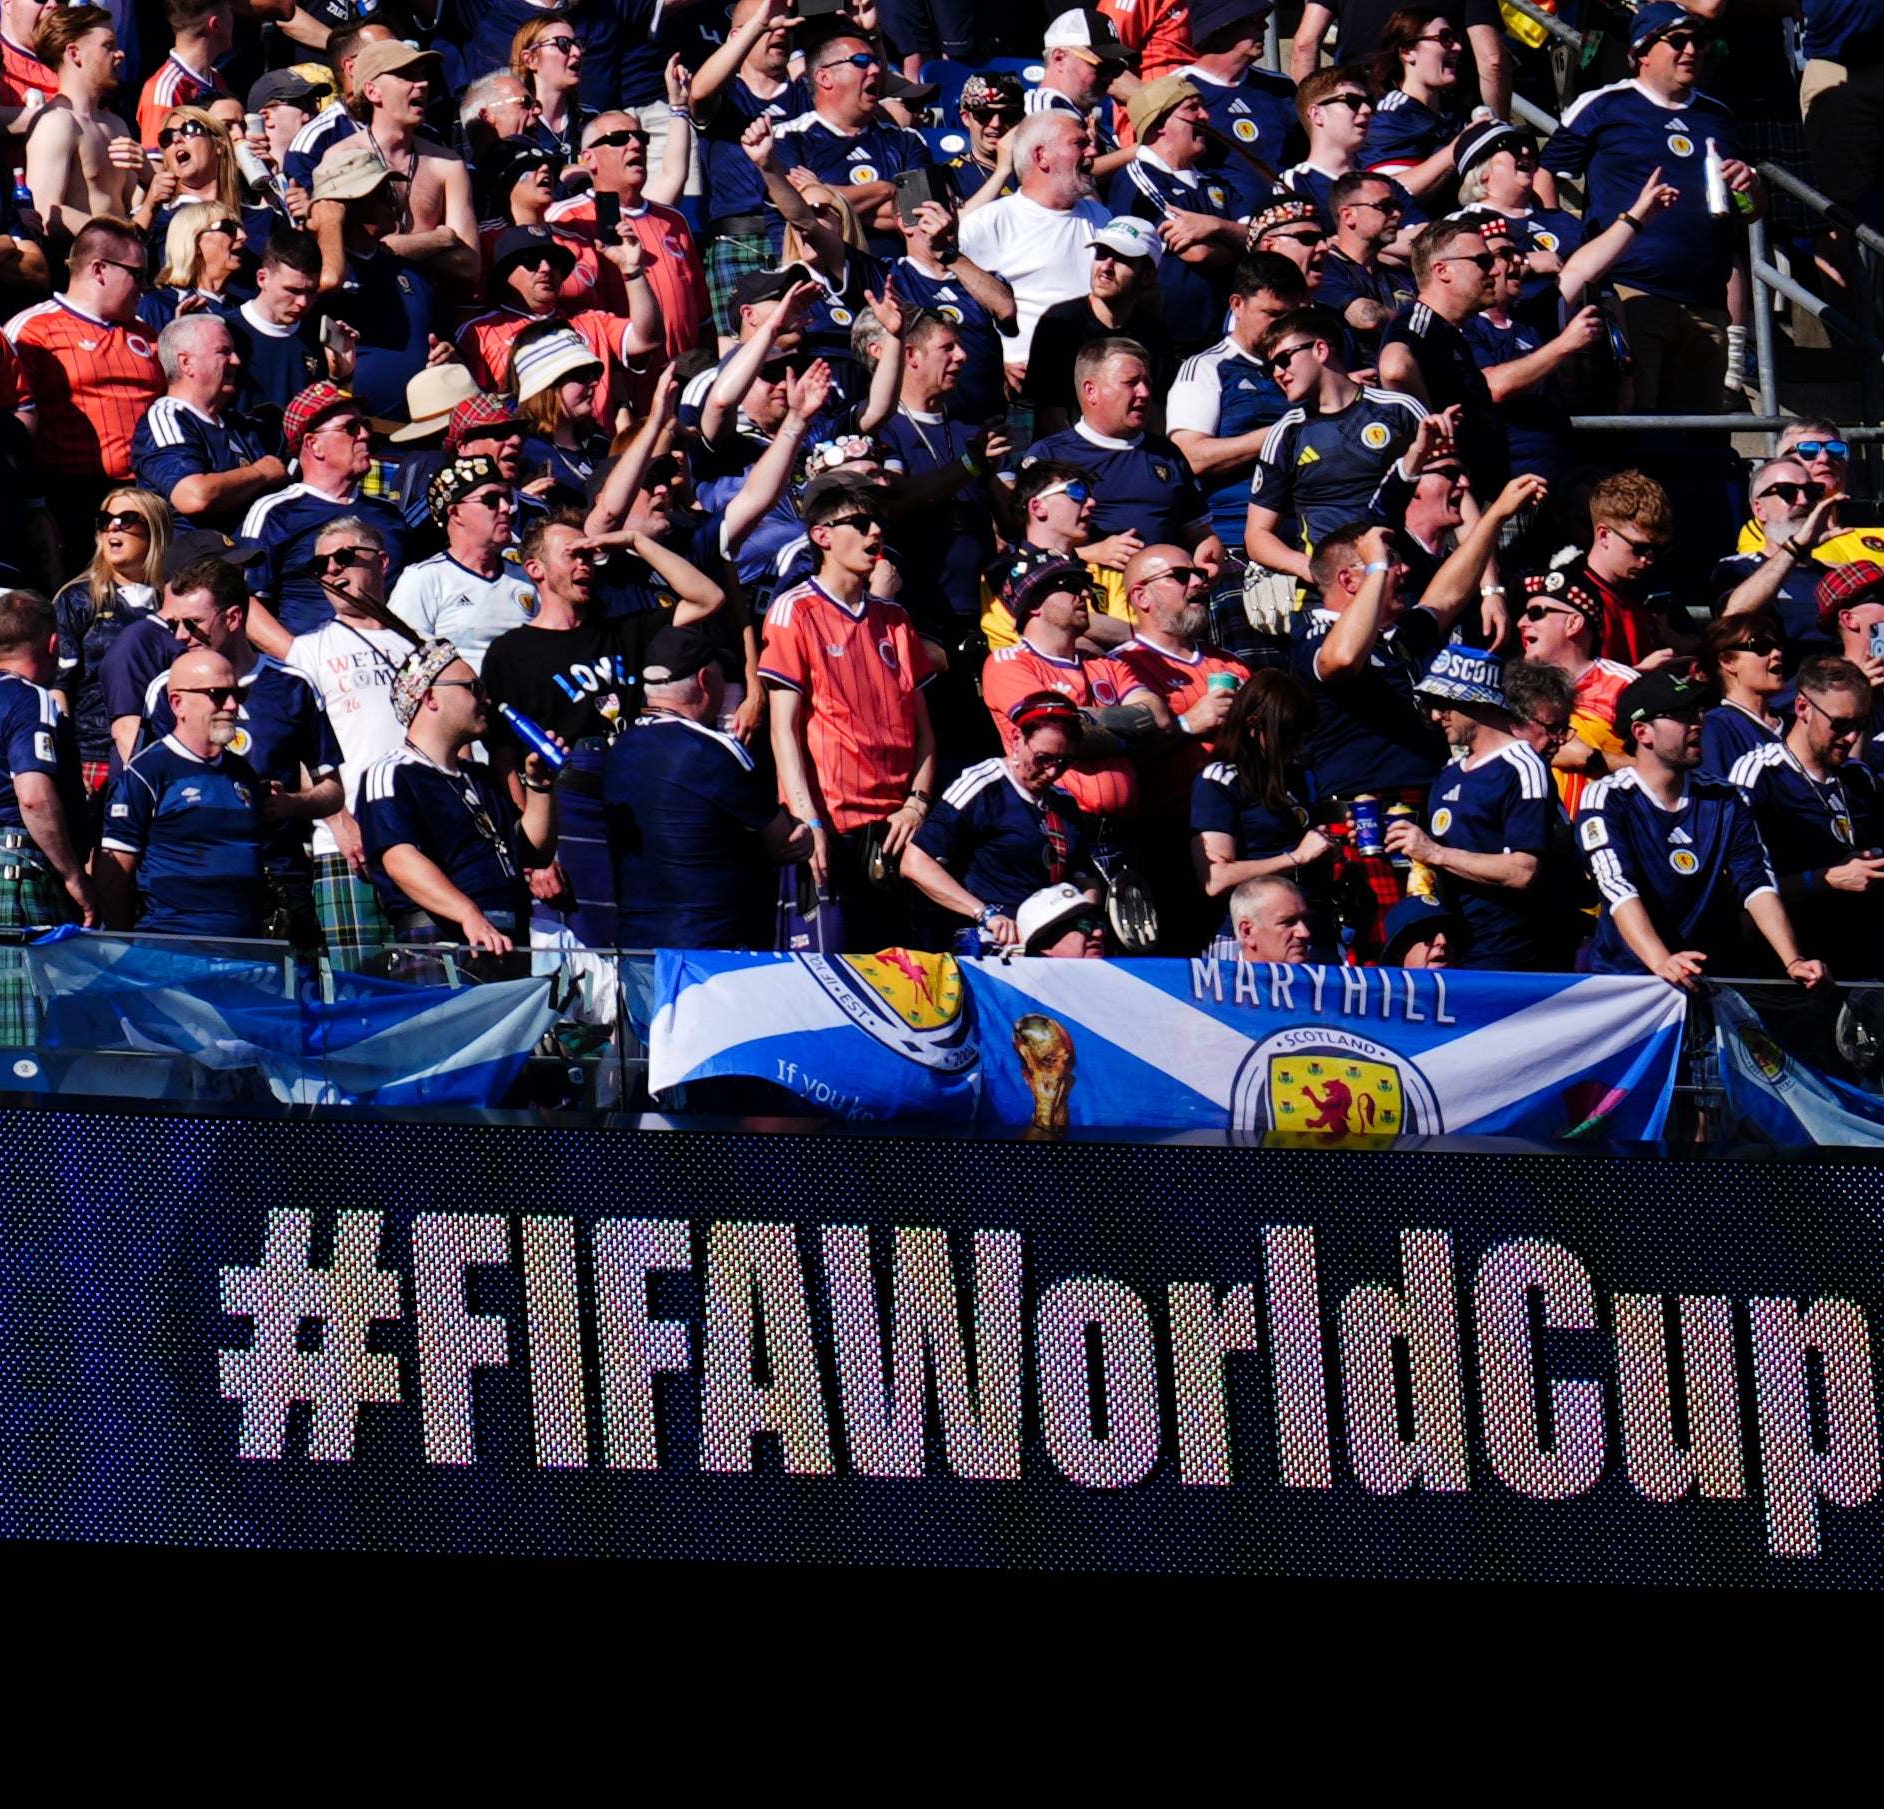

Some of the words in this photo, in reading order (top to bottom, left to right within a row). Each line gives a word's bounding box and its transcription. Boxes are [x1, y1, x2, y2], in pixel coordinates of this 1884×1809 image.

[1448, 658, 1499, 687] SCOTL
[839, 993, 871, 1020] EST
[1190, 957, 1456, 1024] MARYHILL
[1284, 1030, 1377, 1056] SCOTLAND
[777, 1058, 799, 1084] If
[801, 1073, 846, 1111] you
[217, 1208, 1884, 1558] #FIFAWorldCup
